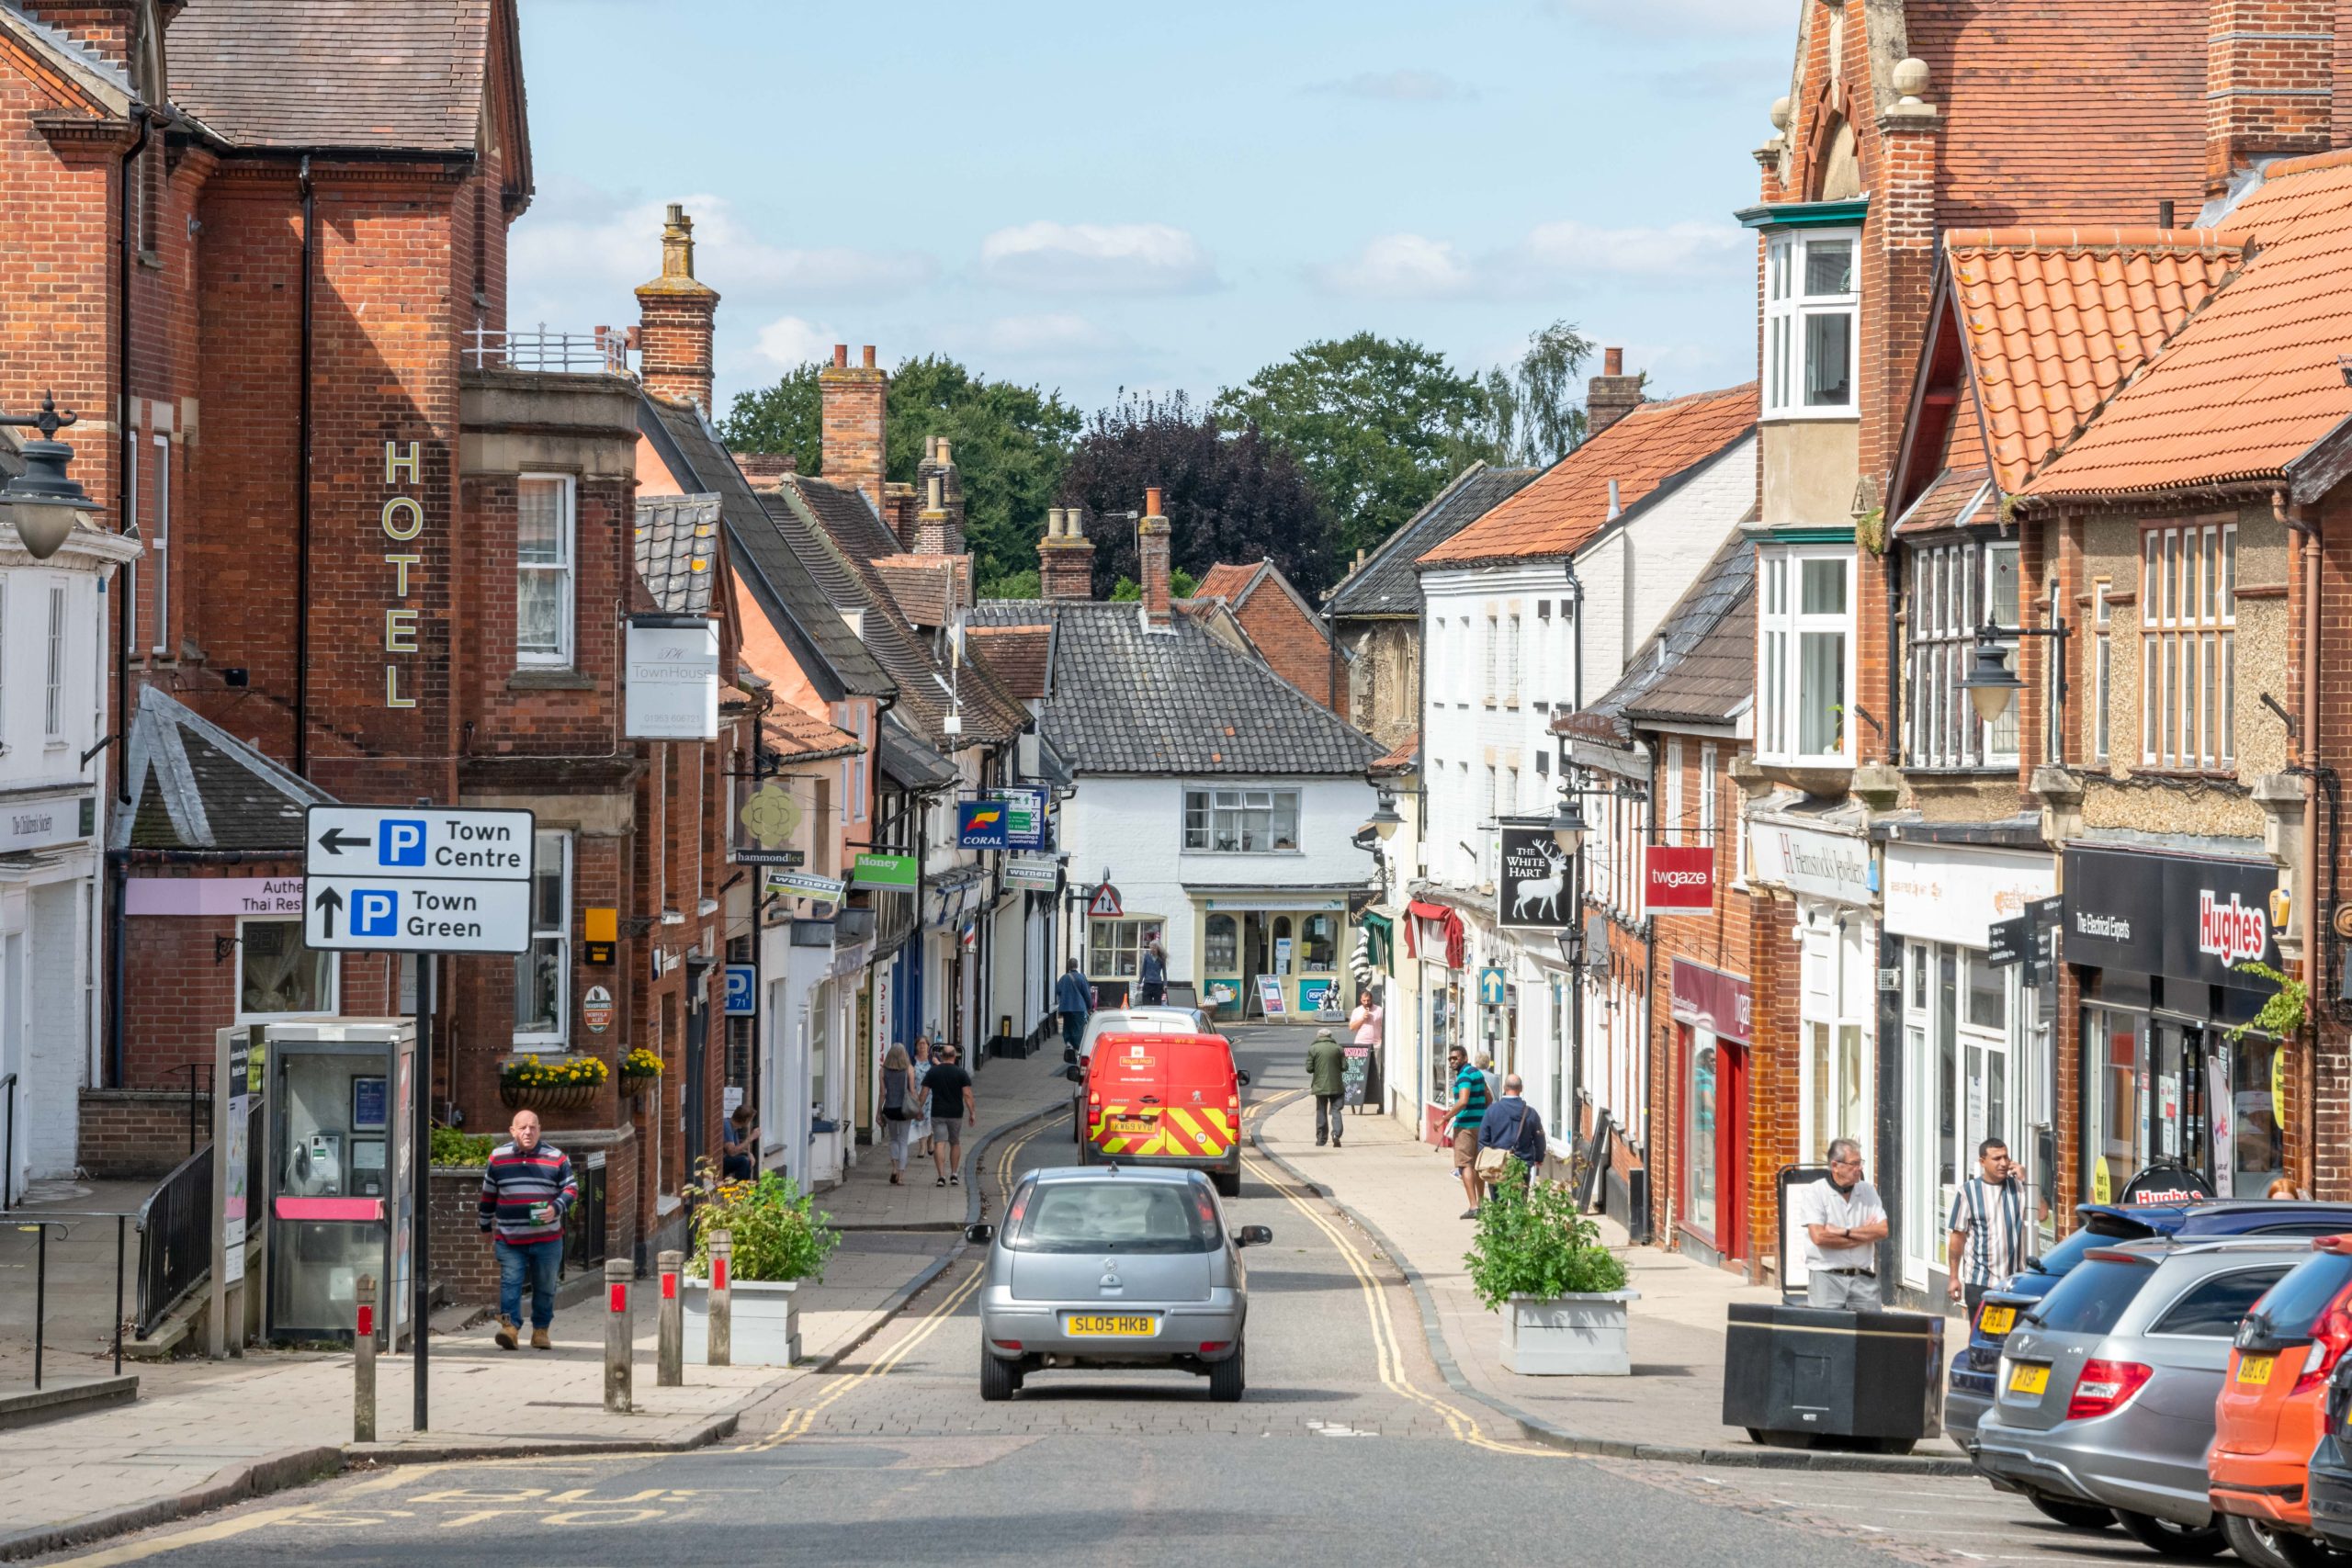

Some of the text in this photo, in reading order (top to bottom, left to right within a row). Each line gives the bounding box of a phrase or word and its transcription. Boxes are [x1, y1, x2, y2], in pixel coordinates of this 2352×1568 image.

[381, 441, 424, 708] HOTEL
[632, 665, 711, 679] TownHouse
[446, 820, 510, 841] Town
[963, 836, 1002, 845] CORAL
[435, 846, 521, 867] Centre
[737, 852, 802, 863] hammondlee
[1516, 847, 1535, 856] THE
[858, 855, 899, 871] Money
[1507, 856, 1545, 867] WHITE
[1010, 869, 1052, 878] warners
[1509, 867, 1543, 877] HART
[1652, 868, 1706, 888] twgaze
[263, 880, 304, 894] Authe
[775, 876, 836, 890] warners
[242, 897, 271, 911] Thai
[412, 890, 477, 911] Town
[406, 916, 481, 937] Green
[2076, 912, 2130, 942] The Electrical Experts
[2200, 894, 2264, 962] Hughes
[1114, 1122, 1136, 1131] KW69
[1075, 1317, 1148, 1331] SL05 HKB
